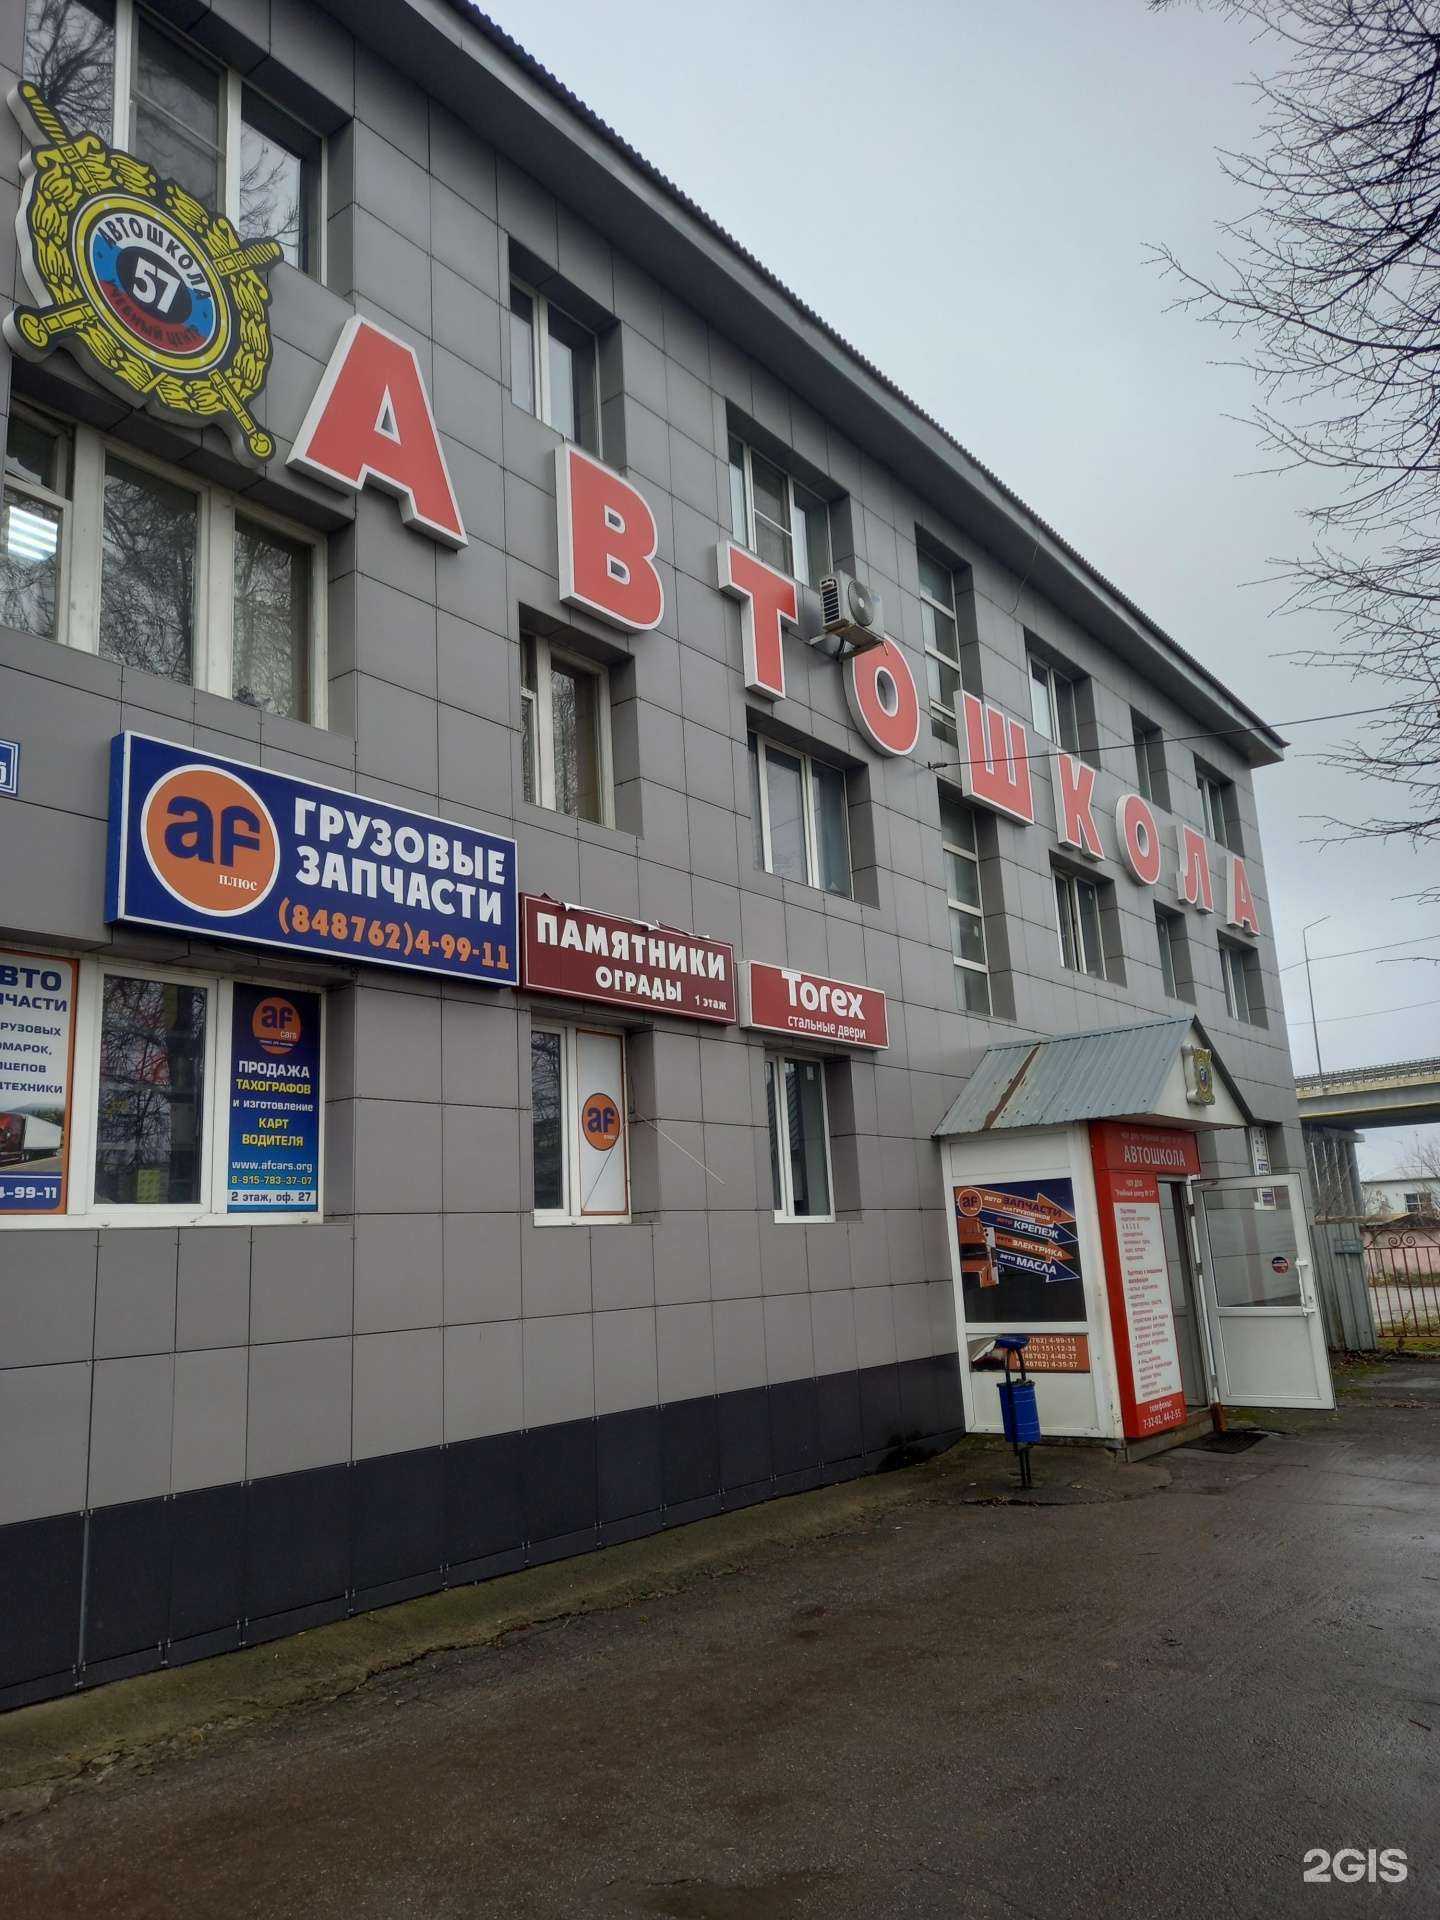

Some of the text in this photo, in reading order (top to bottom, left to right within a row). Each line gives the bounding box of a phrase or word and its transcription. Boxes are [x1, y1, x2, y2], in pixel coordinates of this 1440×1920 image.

[98, 217, 212, 299] АВТОШКОЛА
[132, 256, 182, 314] 57
[286, 314, 1260, 938] АВТОШКОЛА
[164, 795, 261, 868] af
[294, 797, 506, 885] ГРУЗОВЫЕ
[219, 874, 257, 891] плюс
[295, 845, 502, 925] ЗАПЧАСТИ
[278, 896, 510, 970] (848762)4-99-11
[536, 911, 726, 982] ПАМЯТНИКИ
[595, 966, 682, 1002] ОГРАДЫ
[0, 992, 67, 1012] ЧАСТИ
[694, 995, 728, 1011] 1 этаж
[781, 970, 866, 1021] Torex
[788, 1015, 867, 1042] стальные двери
[0, 1042, 52, 1055] МАРОК,
[0, 1062, 47, 1073] ЦЕПОВ
[238, 1060, 310, 1078] ПРОДАЖА
[236, 1079, 312, 1094] ТАХОГРАФОВ
[233, 1099, 313, 1112] и изготовление
[258, 1118, 289, 1129] КАРТ
[242, 1133, 304, 1146] ВОДИТЕЛЯ
[1124, 1145, 1186, 1167] АВТОШКОЛА
[231, 1161, 313, 1173] www.afcars.org
[231, 1191, 311, 1204] 2 этаж, оф. 27
[1013, 1221, 1059, 1240] КРЕПЕЖ
[1012, 1239, 1063, 1258] ЭЛЕКТРИКА
[1016, 1257, 1057, 1275] МАСЛА
